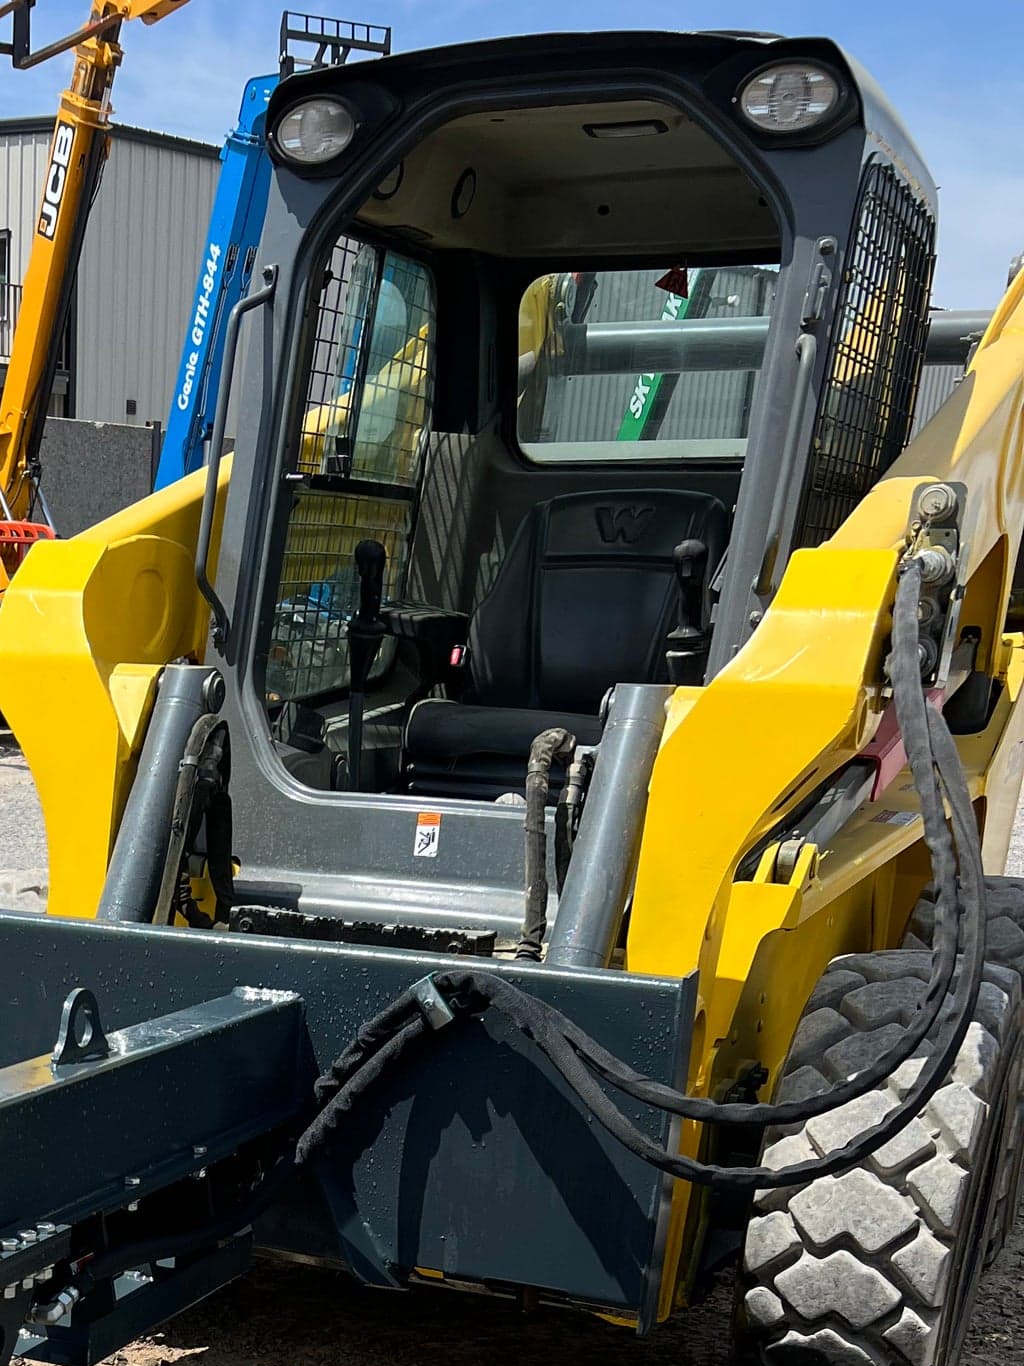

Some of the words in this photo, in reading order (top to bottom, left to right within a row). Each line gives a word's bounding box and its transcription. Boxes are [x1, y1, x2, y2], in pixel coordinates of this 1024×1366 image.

[38, 124, 75, 238] JCB
[177, 351, 200, 411] Genie
[191, 243, 222, 347] GTH-844
